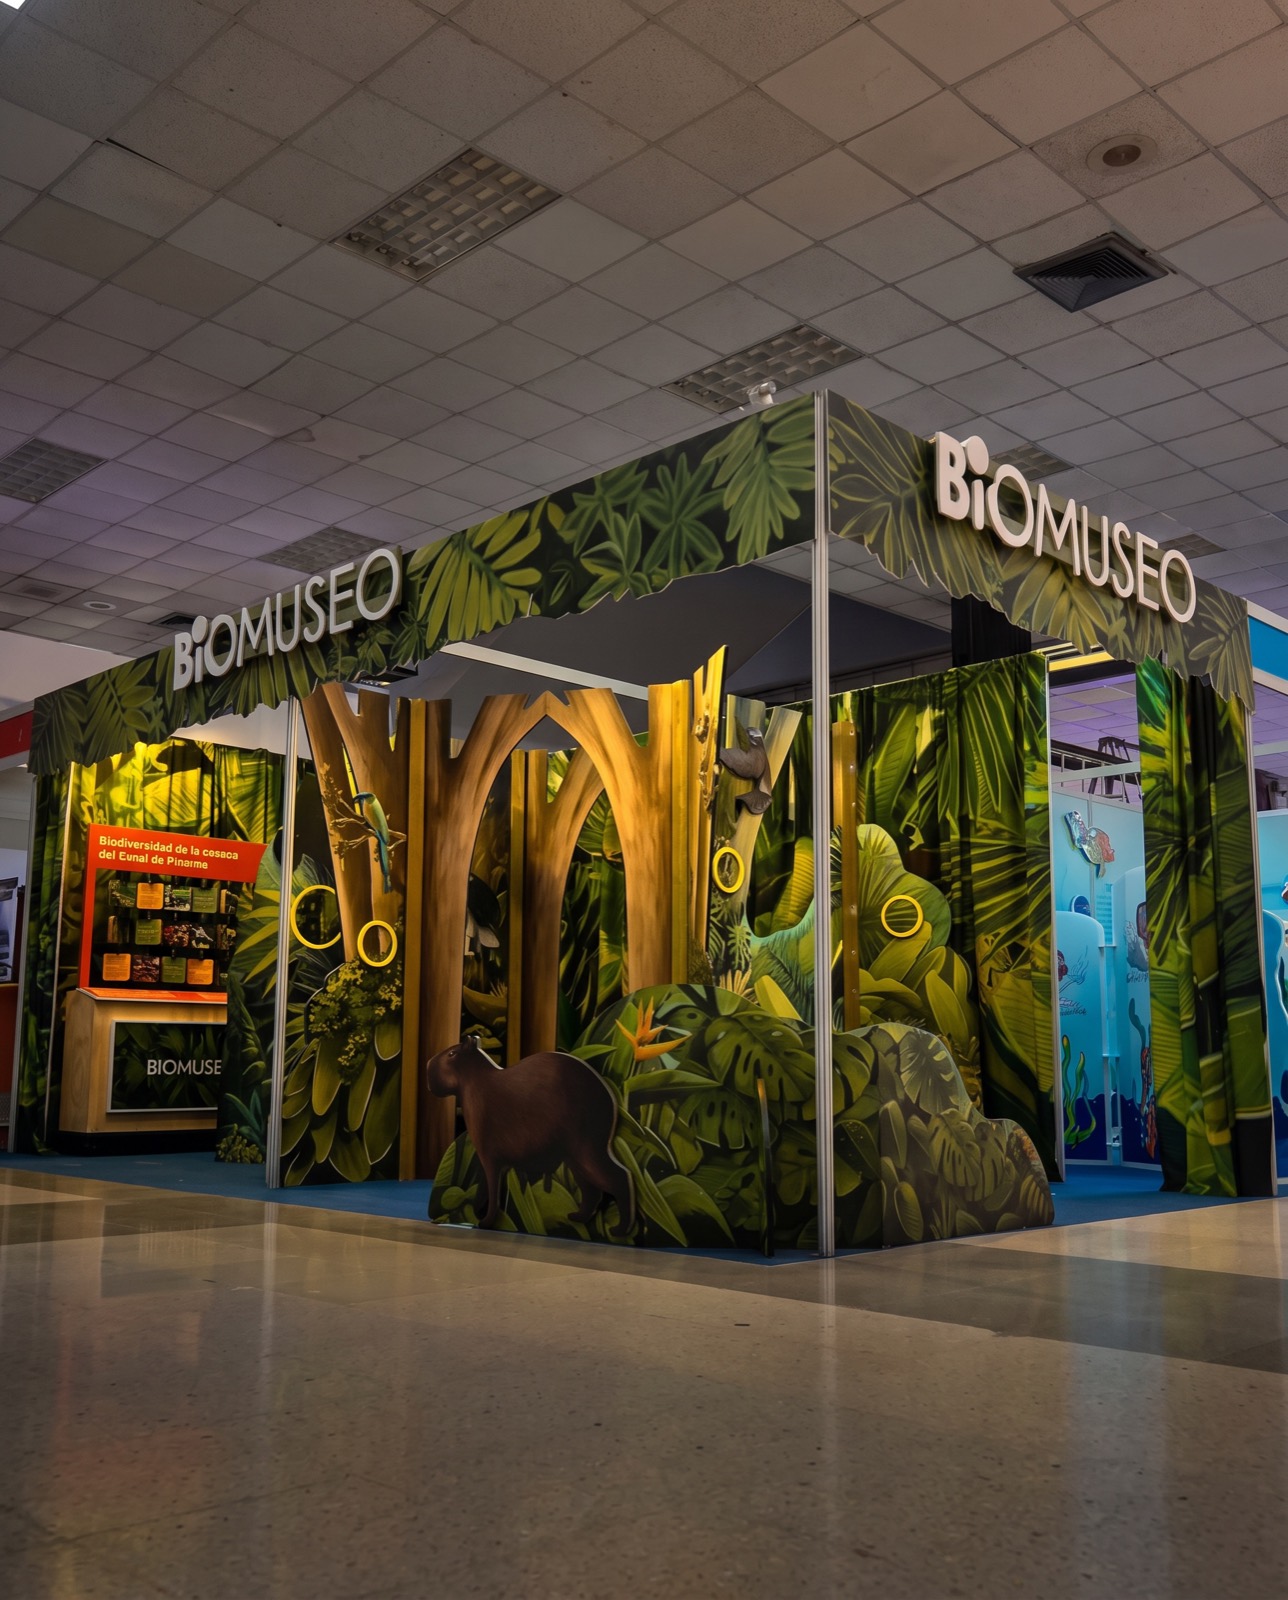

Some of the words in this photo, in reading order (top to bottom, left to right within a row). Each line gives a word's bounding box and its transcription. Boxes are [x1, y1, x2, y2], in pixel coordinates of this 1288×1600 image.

[99, 835, 173, 852] Biodiversidad
[175, 844, 188, 854] de
[190, 845, 200, 856] la
[98, 849, 116, 860] del
[151, 854, 164, 865] de
